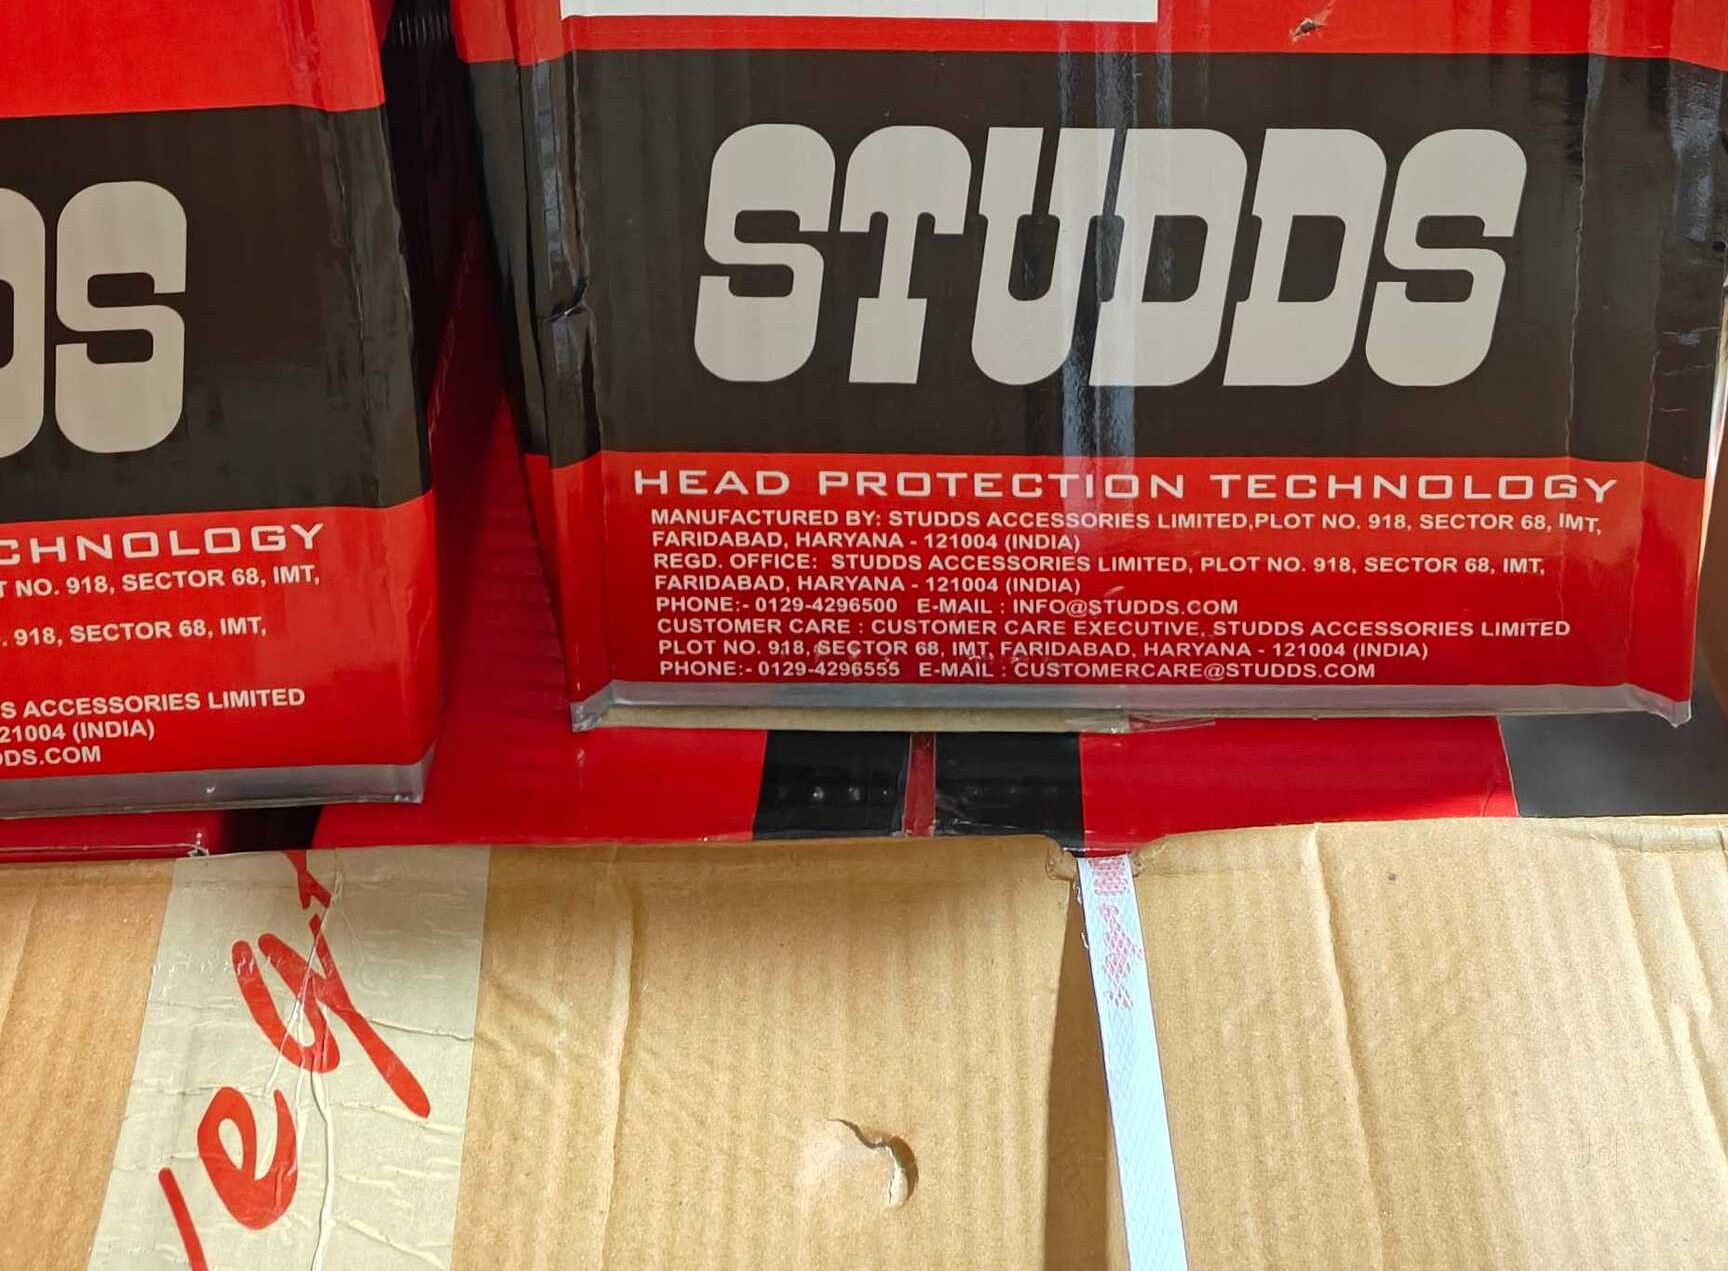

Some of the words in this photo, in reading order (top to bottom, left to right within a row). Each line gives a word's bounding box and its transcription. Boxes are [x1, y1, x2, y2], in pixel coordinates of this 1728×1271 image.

[693, 123, 1529, 388] STUDDS
[634, 470, 790, 495] HEAD
[818, 471, 1184, 499] PROTECTION
[1209, 474, 1617, 502] TECHNOLOGY
[651, 508, 839, 526] MANUFACTURED
[845, 510, 881, 526] BY:
[888, 510, 981, 527] STUDDS
[986, 512, 1151, 529] ACCESSORIES
[1157, 513, 1315, 529] LIMITED,PLOT
[1322, 513, 1361, 529] NO.
[1368, 513, 1412, 530] 918,
[1419, 513, 1514, 530] SECTOR
[1520, 514, 1552, 531] 68,
[1558, 513, 1602, 535] IMT,
[656, 596, 749, 612] PHONE:-
[755, 597, 898, 613] 0129-4296500
[917, 598, 993, 614] E-MAIL
[1013, 599, 1238, 617] INFO@STUDDS.COM
